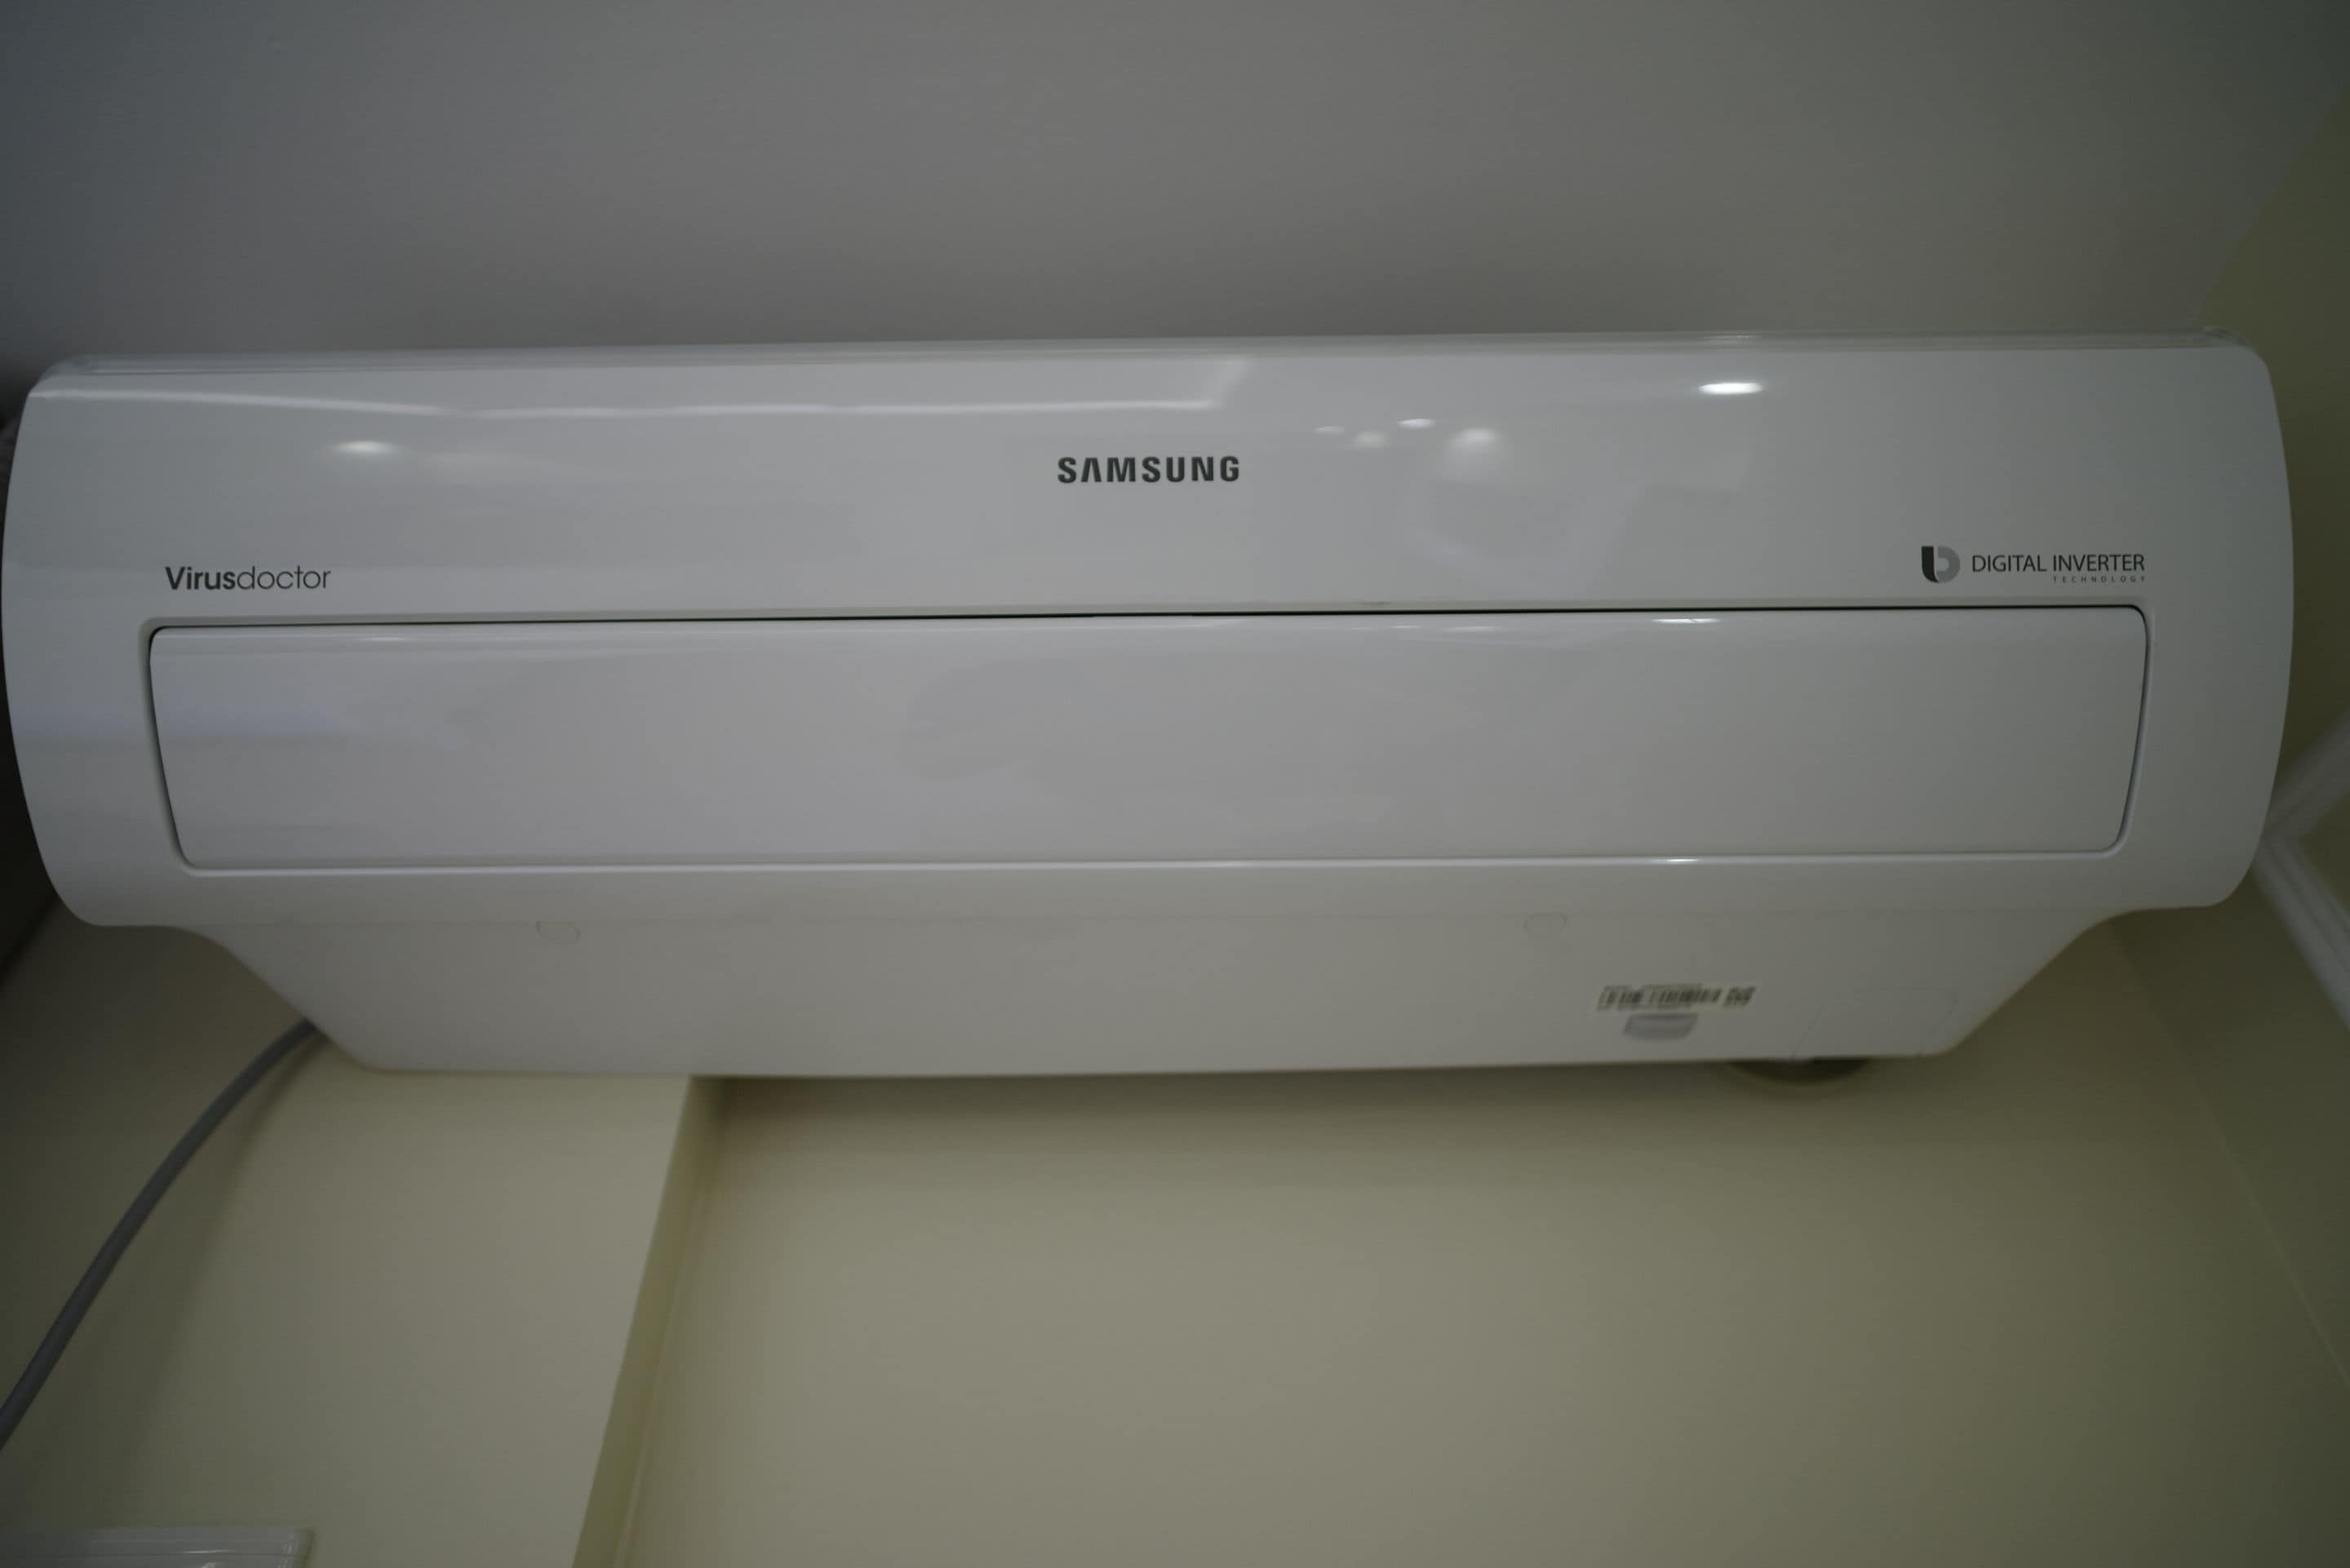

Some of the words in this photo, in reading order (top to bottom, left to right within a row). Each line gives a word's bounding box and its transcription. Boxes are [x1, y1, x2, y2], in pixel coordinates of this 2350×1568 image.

[1058, 456, 1239, 483] SAMSUNG
[1971, 555, 2047, 572] DIGITAL
[2052, 554, 2146, 571] INVERTER
[165, 565, 331, 590] Virusdoctor
[2052, 575, 2146, 583] TECHNOLOGY
